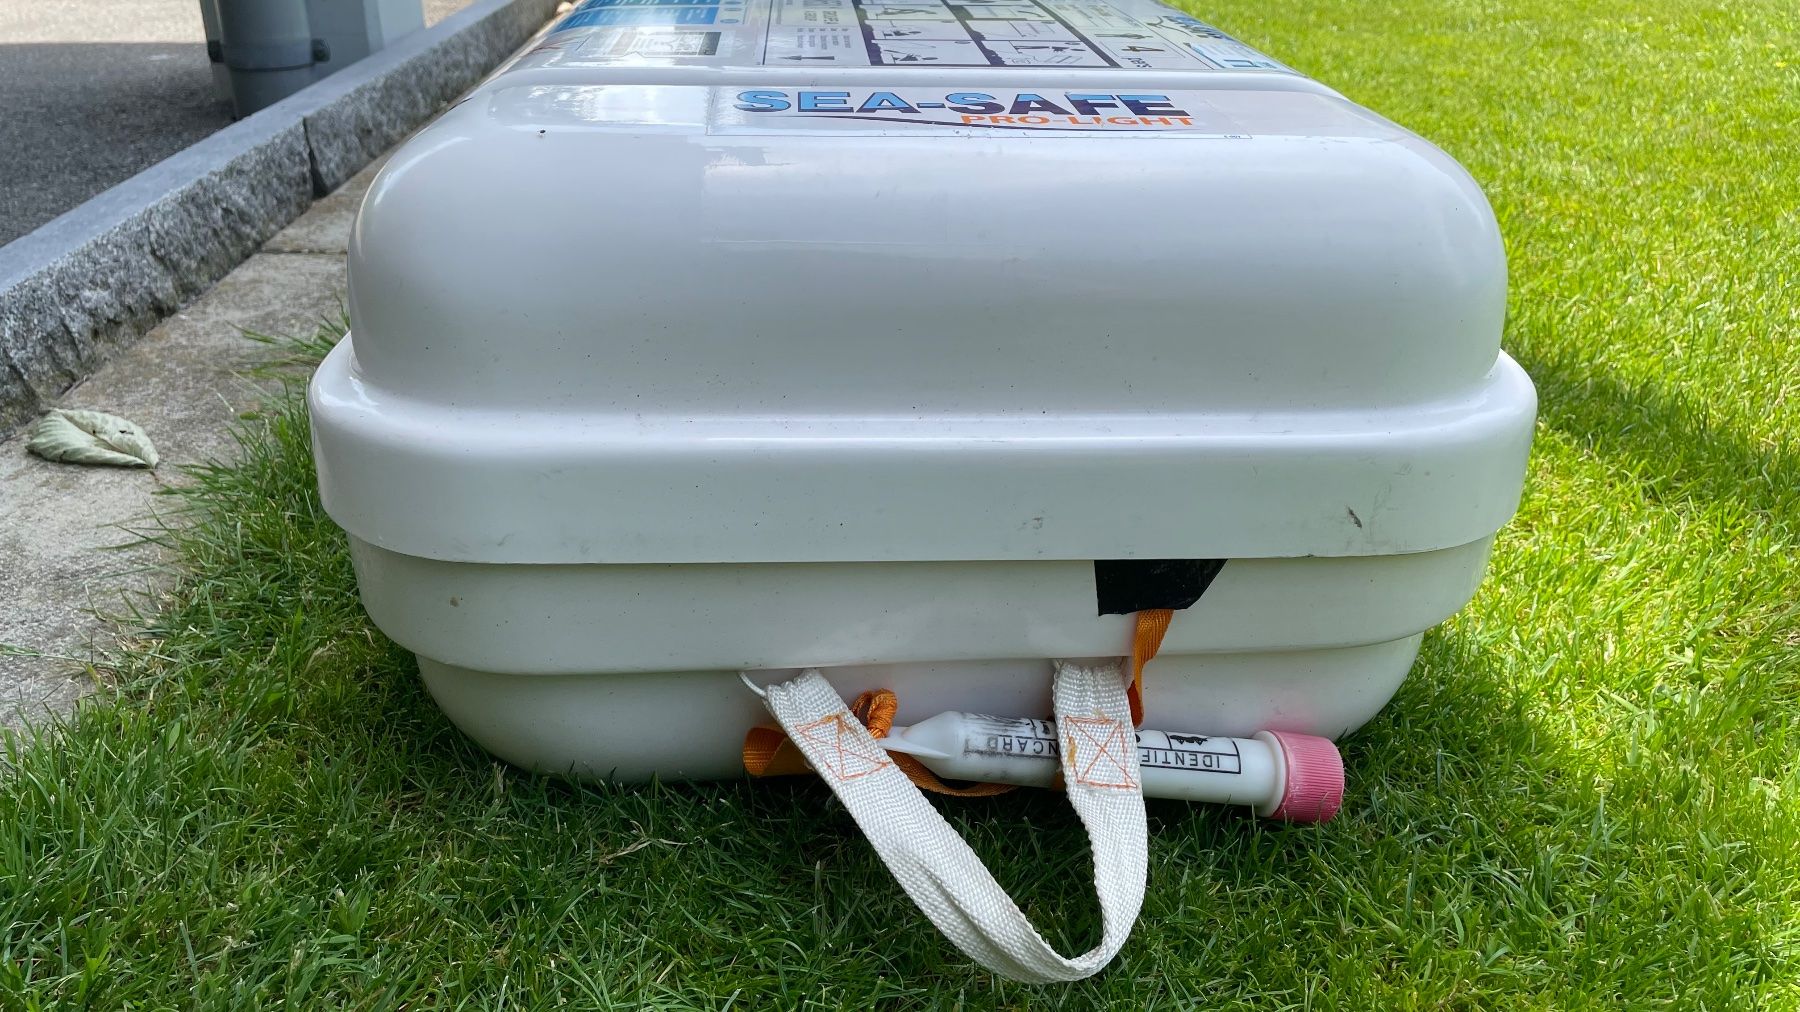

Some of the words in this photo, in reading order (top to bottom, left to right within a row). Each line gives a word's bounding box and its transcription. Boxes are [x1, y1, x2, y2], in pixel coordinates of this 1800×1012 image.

[733, 90, 1191, 117] SEA-SAFE
[961, 115, 1194, 126] PRO-LIGHT
[987, 737, 1058, 755] NCARD
[1141, 750, 1220, 769] IDENTIF
